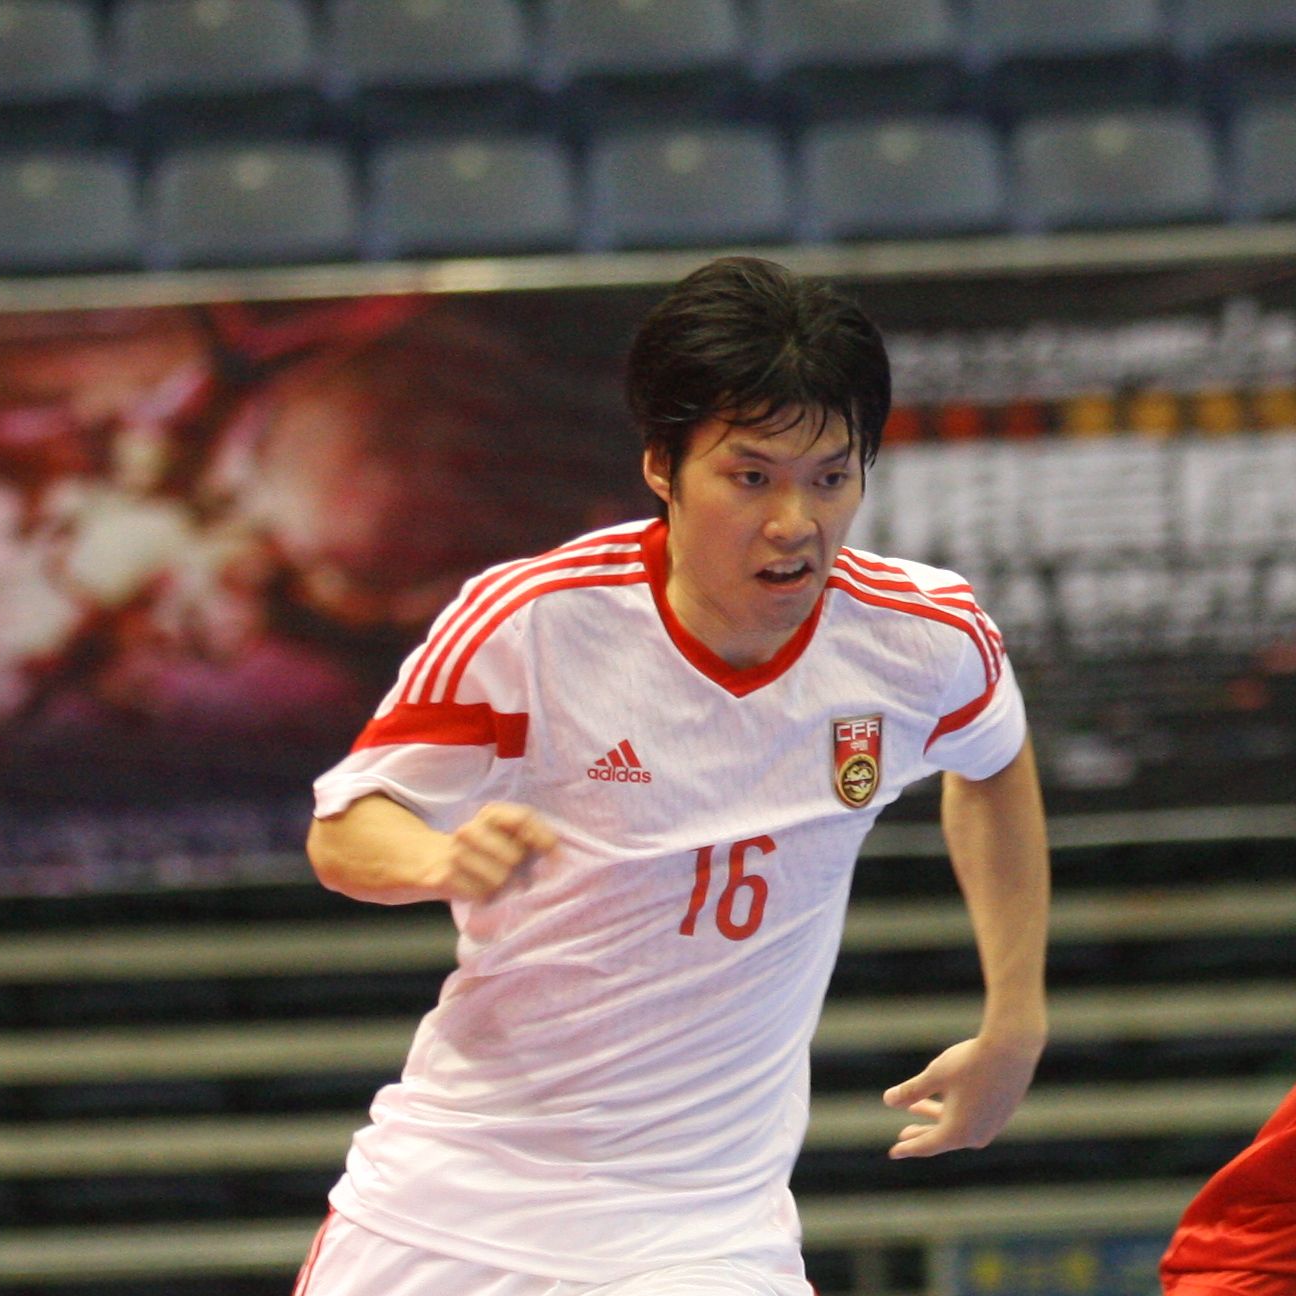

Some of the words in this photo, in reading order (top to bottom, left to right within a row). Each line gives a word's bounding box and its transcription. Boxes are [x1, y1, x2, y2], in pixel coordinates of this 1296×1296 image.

[836, 720, 880, 742] CFA
[587, 765, 652, 783] adidas
[679, 834, 776, 941] 16
